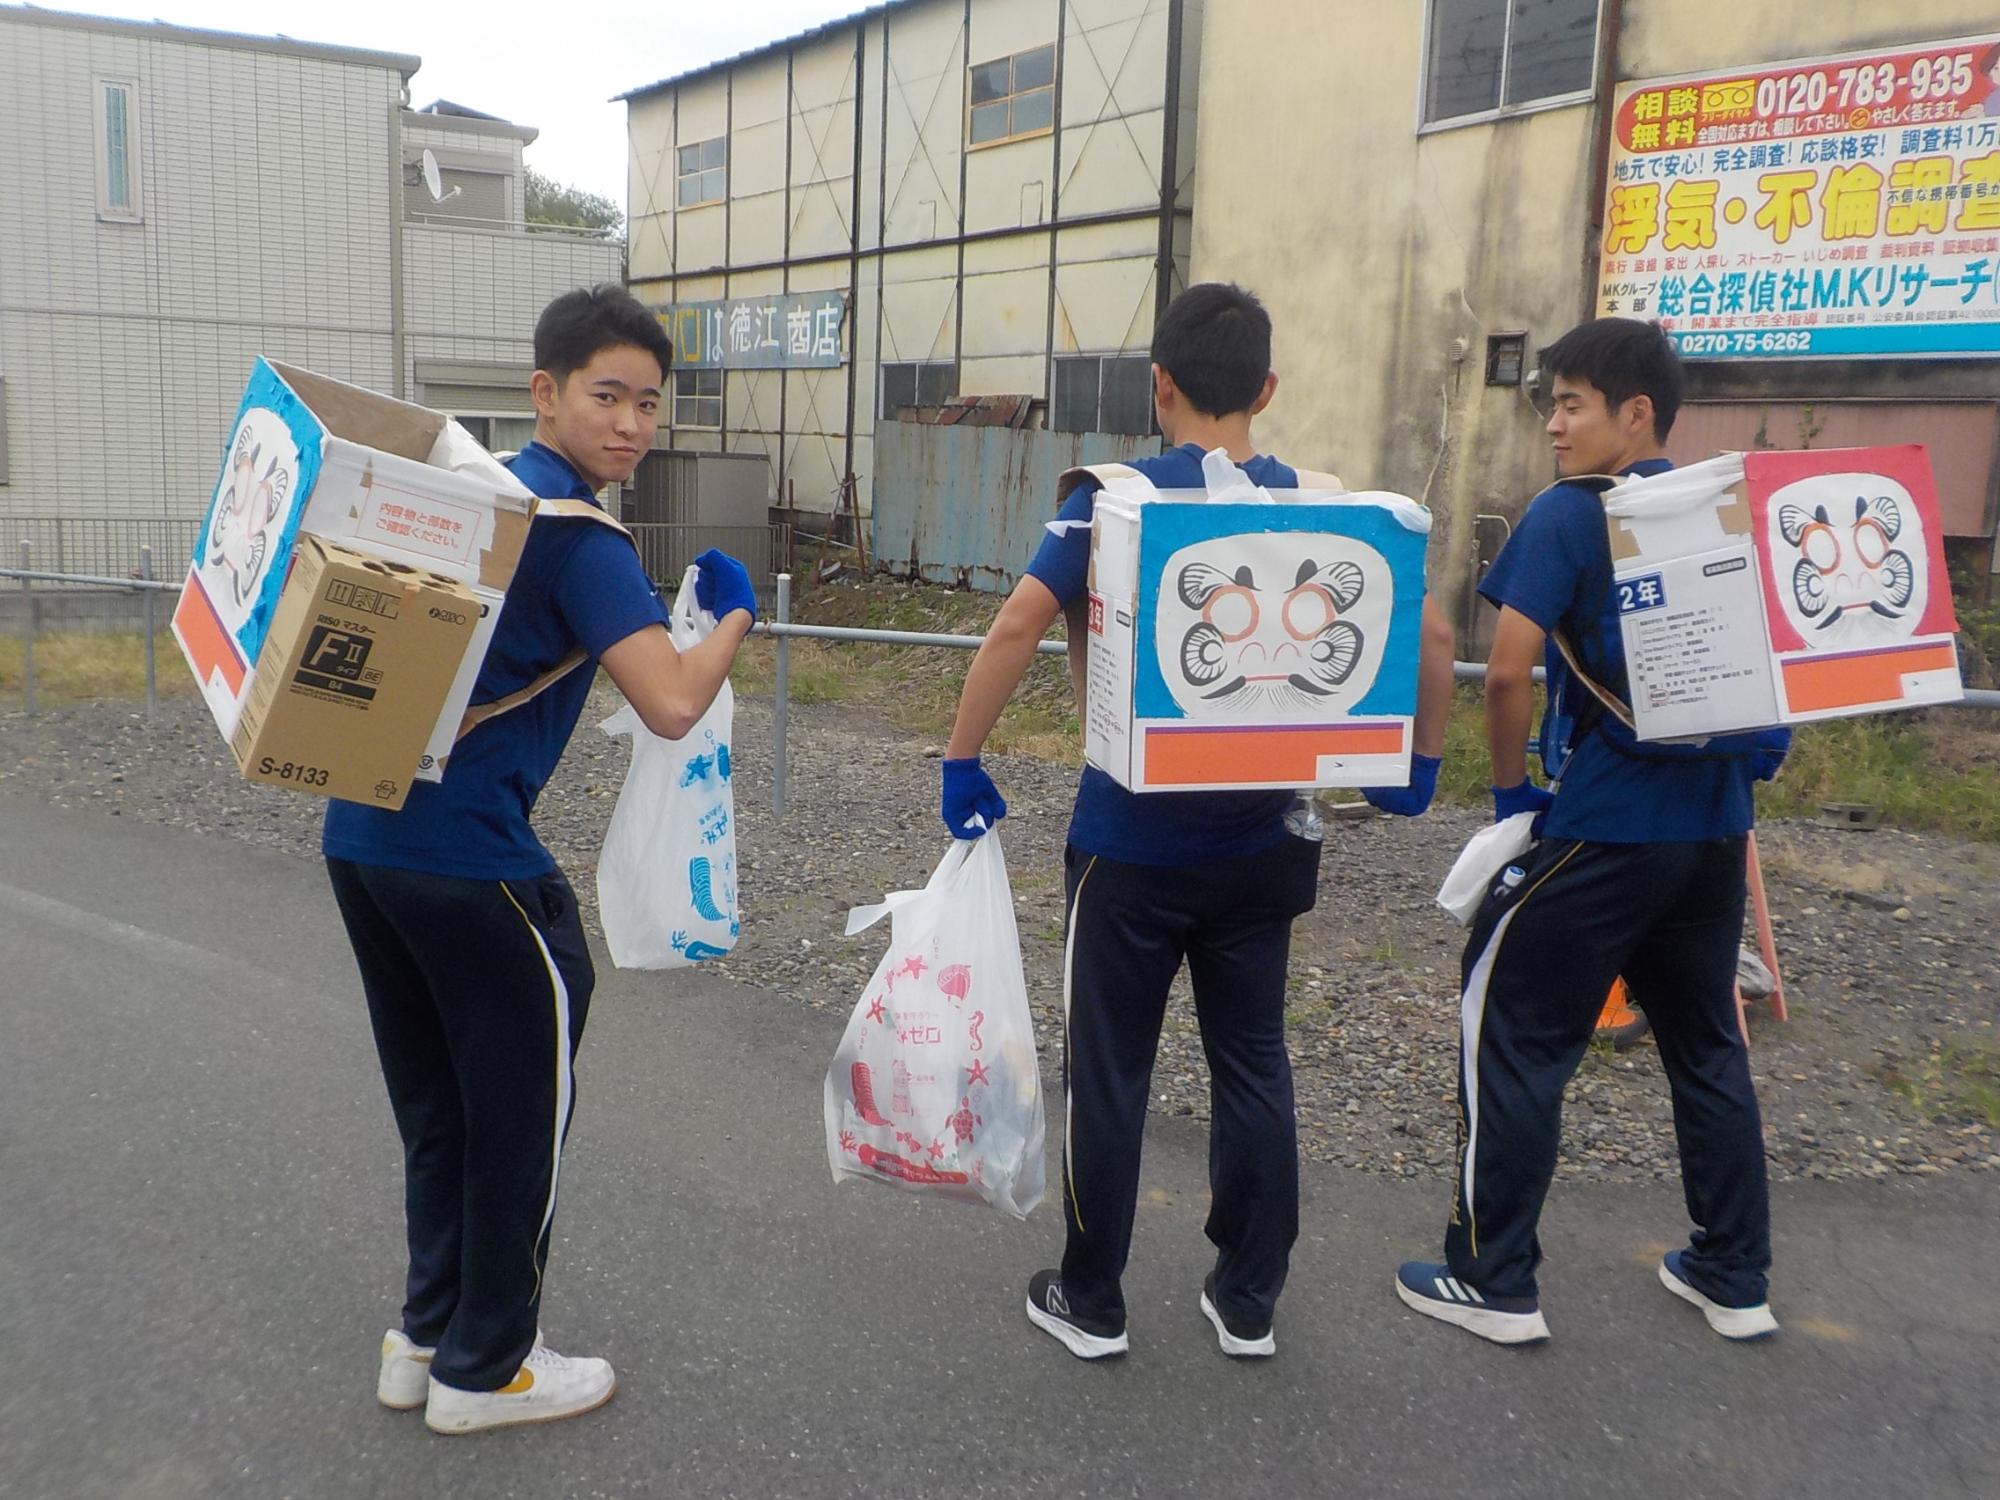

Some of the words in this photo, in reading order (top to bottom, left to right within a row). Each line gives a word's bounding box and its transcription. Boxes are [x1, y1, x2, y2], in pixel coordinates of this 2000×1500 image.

[1756, 52, 1974, 117] 0120-783-935
[1633, 87, 1700, 121] 相談
[1630, 117, 1696, 150] 無料
[1682, 331, 1812, 353] 0270-75-6262
[1619, 579, 1661, 611] 2年
[317, 613, 340, 627] RISO
[343, 620, 377, 634] マスター
[328, 680, 343, 690] B4
[258, 756, 330, 788] S-8133
